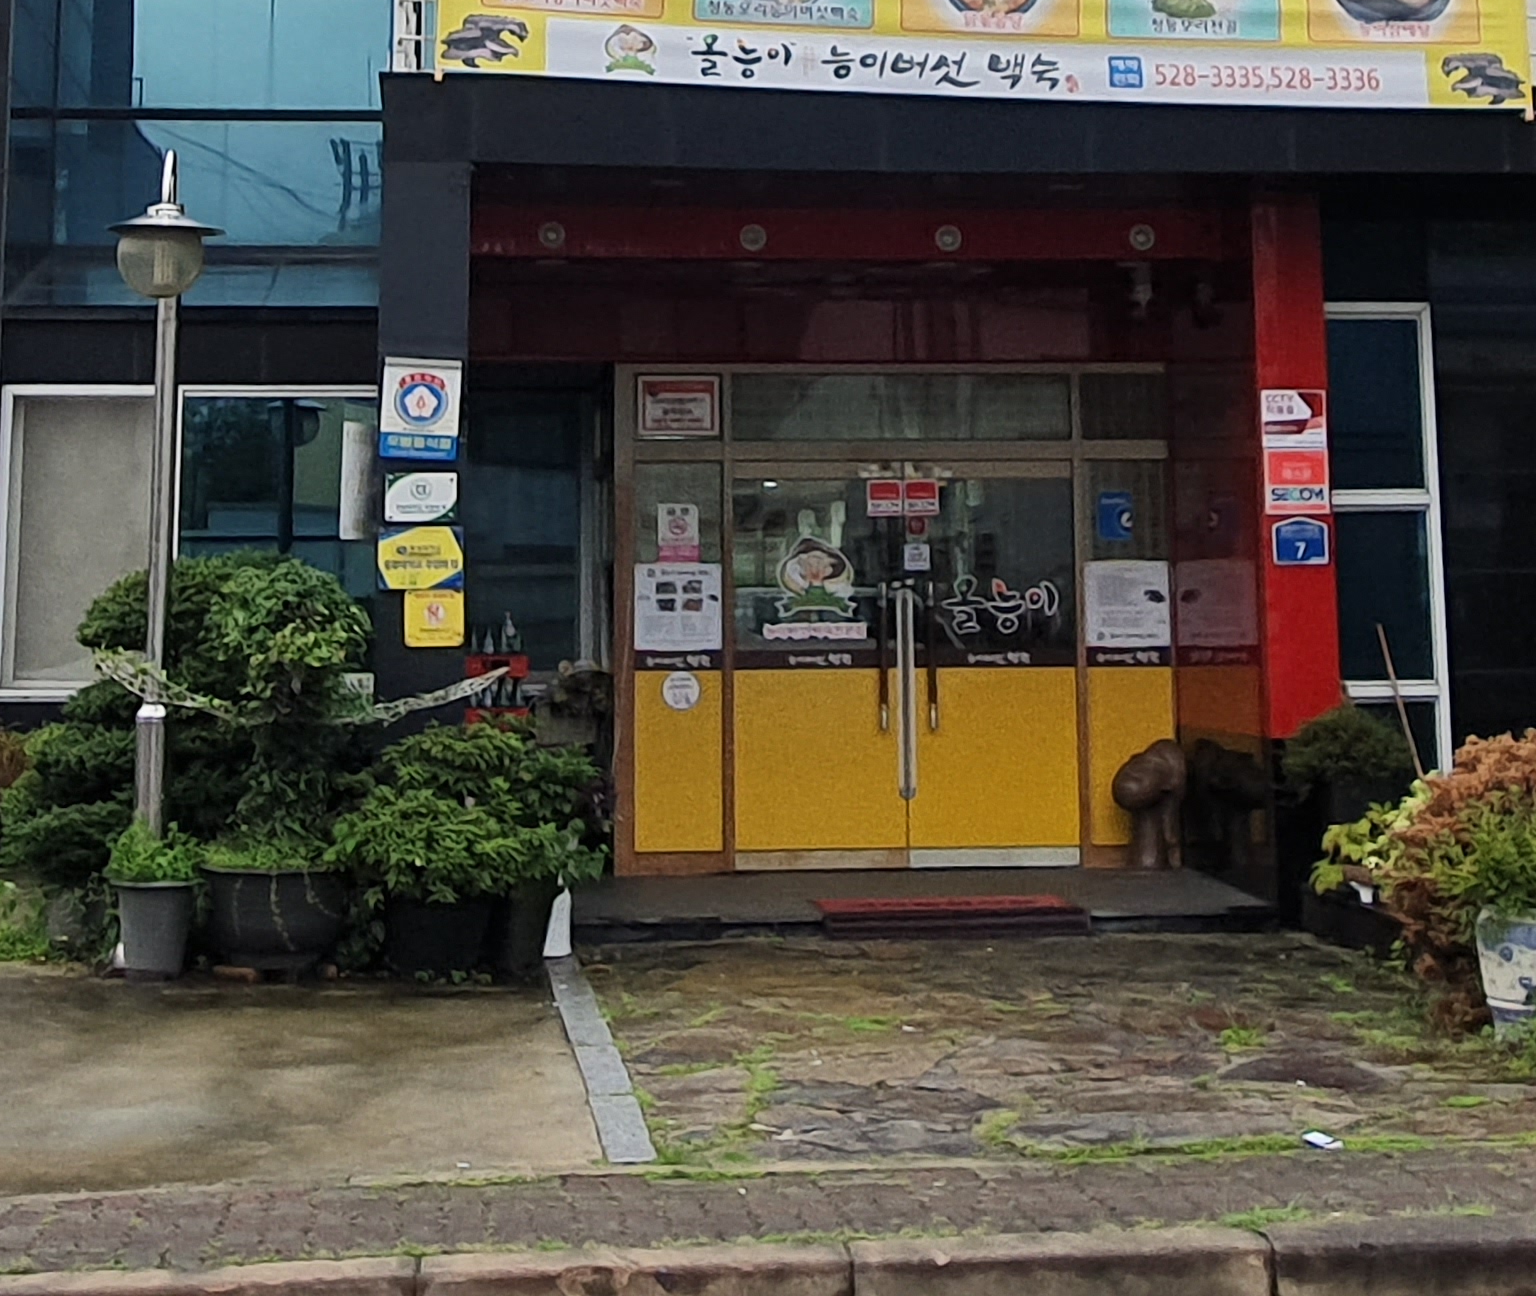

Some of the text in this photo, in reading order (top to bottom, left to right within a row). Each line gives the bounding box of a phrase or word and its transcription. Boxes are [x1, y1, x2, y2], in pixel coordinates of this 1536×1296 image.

[821, 44, 980, 88] 능이버섯
[987, 53, 1061, 91] 백숙
[1265, 393, 1294, 404] CCTV
[1271, 487, 1325, 502] SECOM
[1295, 541, 1306, 560] 7
